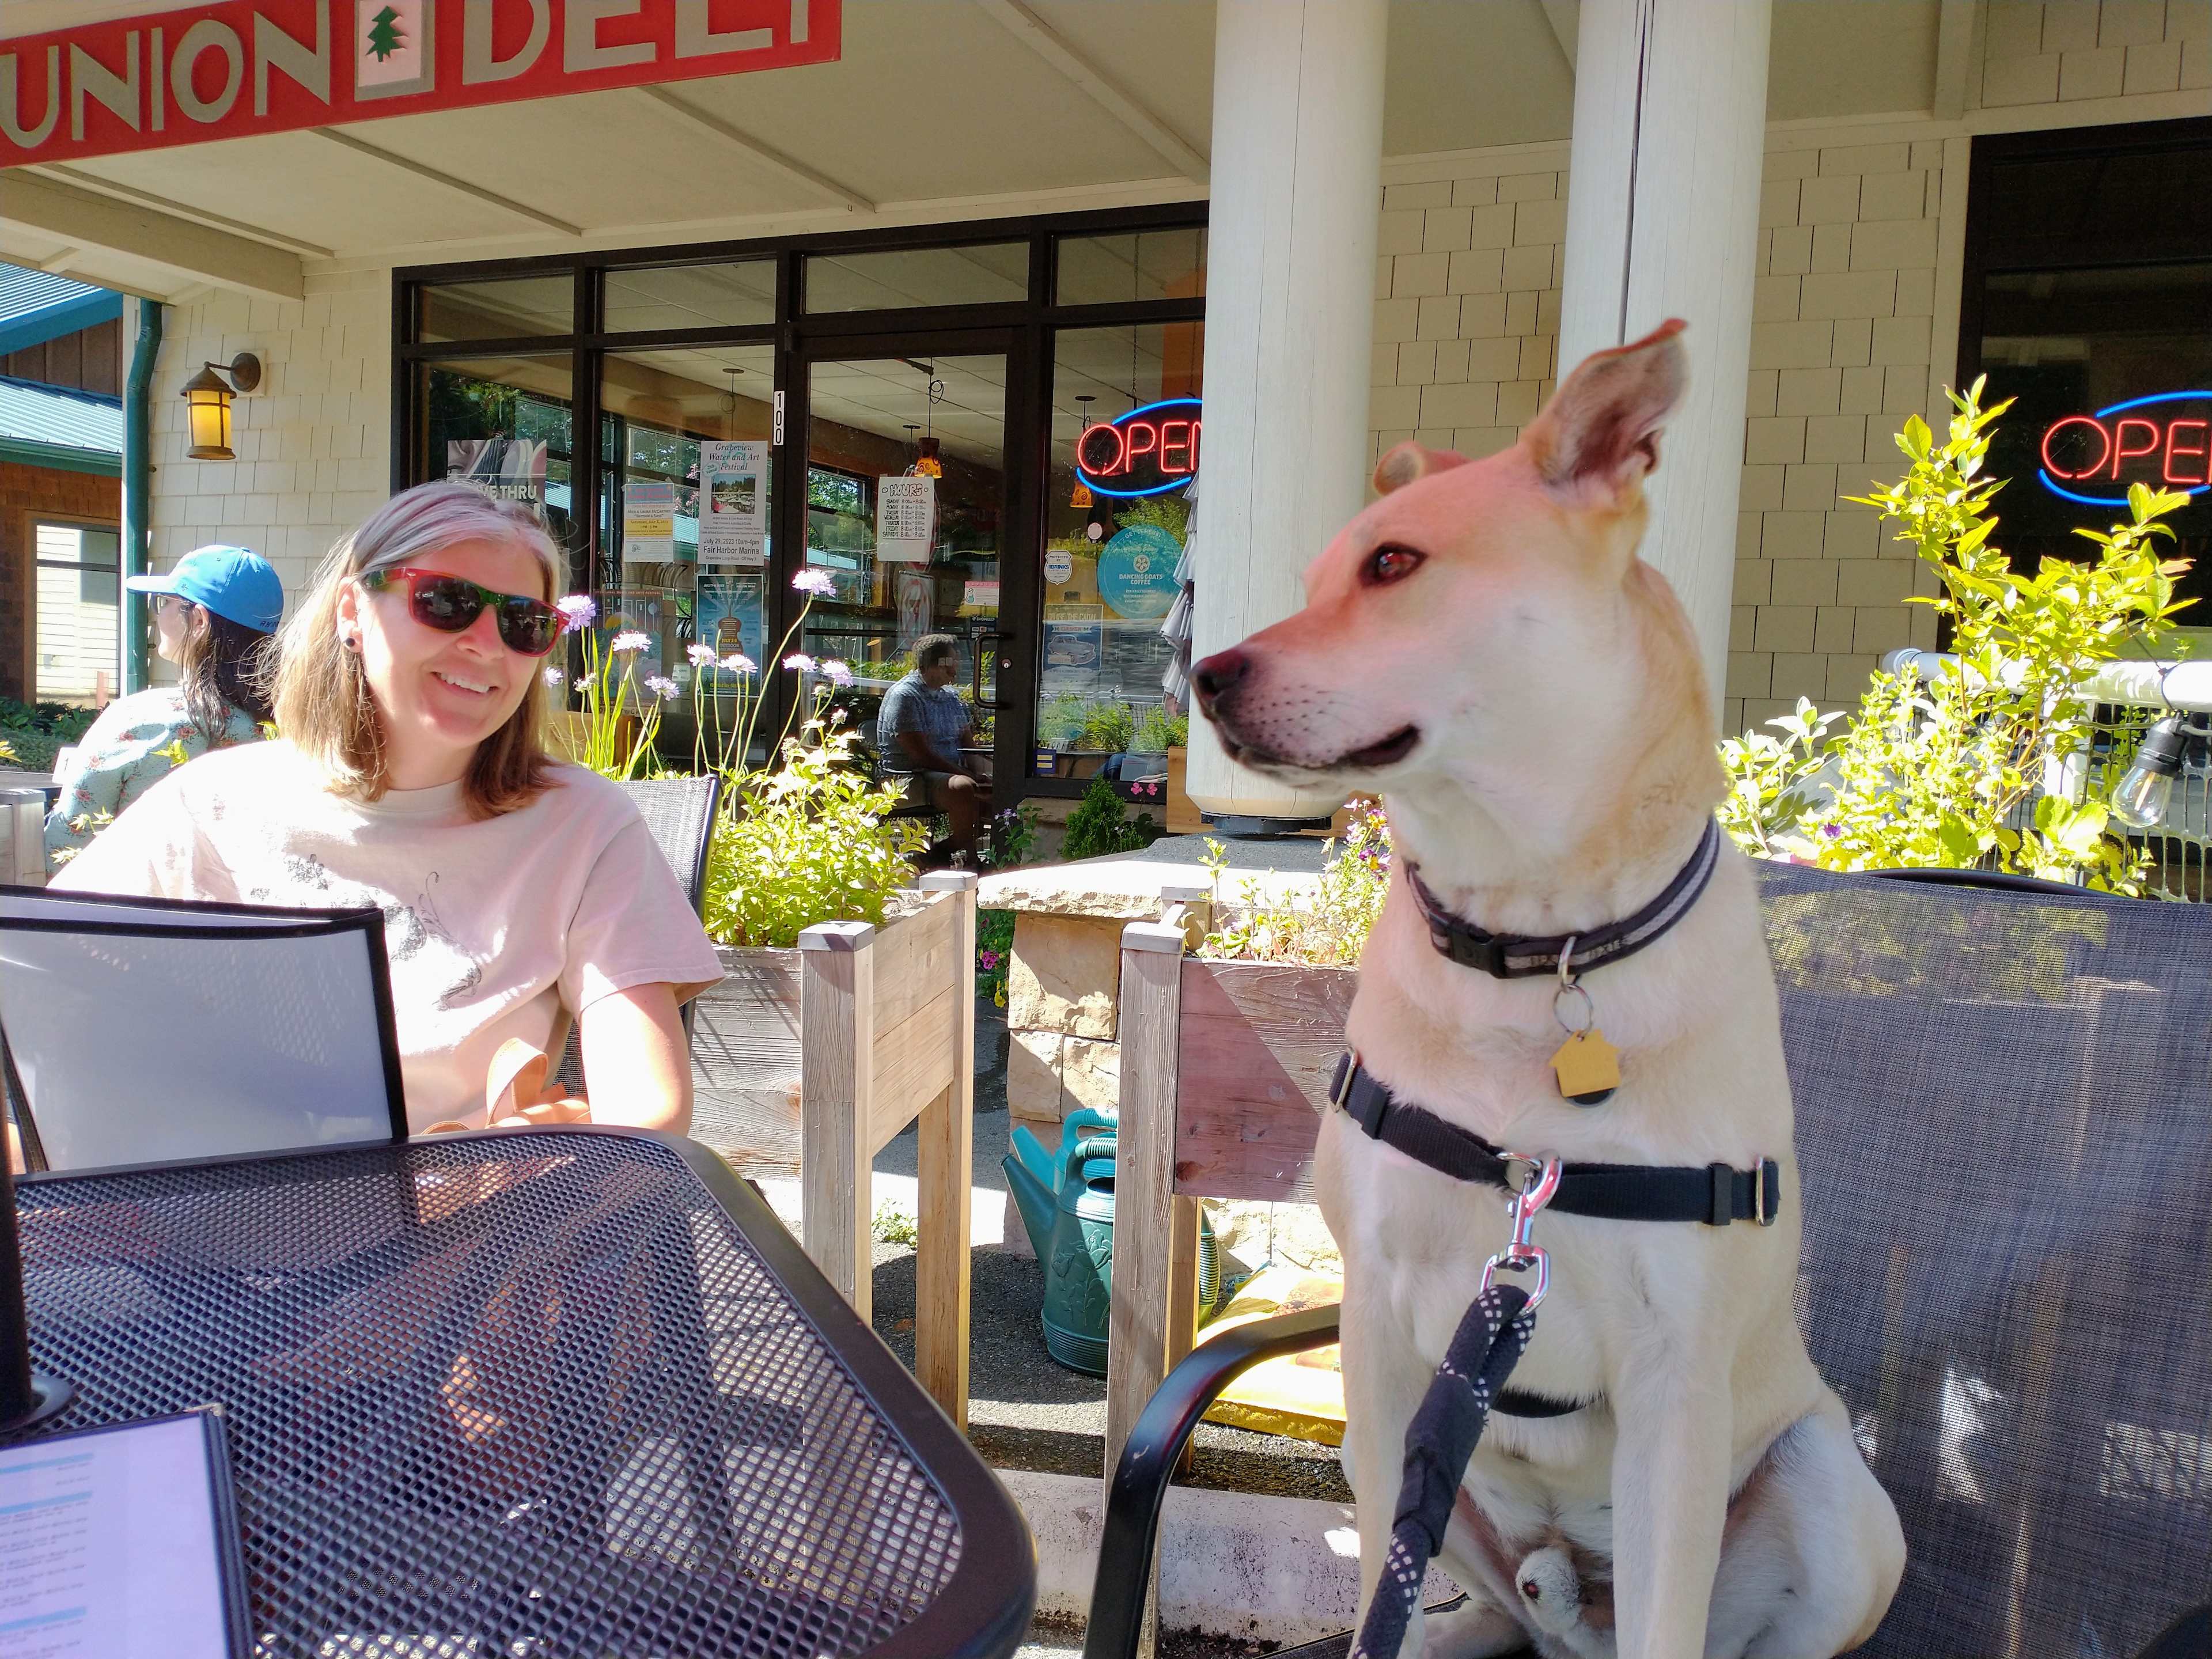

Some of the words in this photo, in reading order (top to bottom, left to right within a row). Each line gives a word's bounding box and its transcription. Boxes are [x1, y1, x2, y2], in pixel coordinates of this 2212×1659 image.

[0, 0, 330, 148] UNION
[715, 443, 754, 452] Grapeview
[2041, 415, 2212, 485] OPE
[732, 452, 745, 460] and
[500, 486, 537, 499] THRU
[890, 483, 923, 497] HOURS
